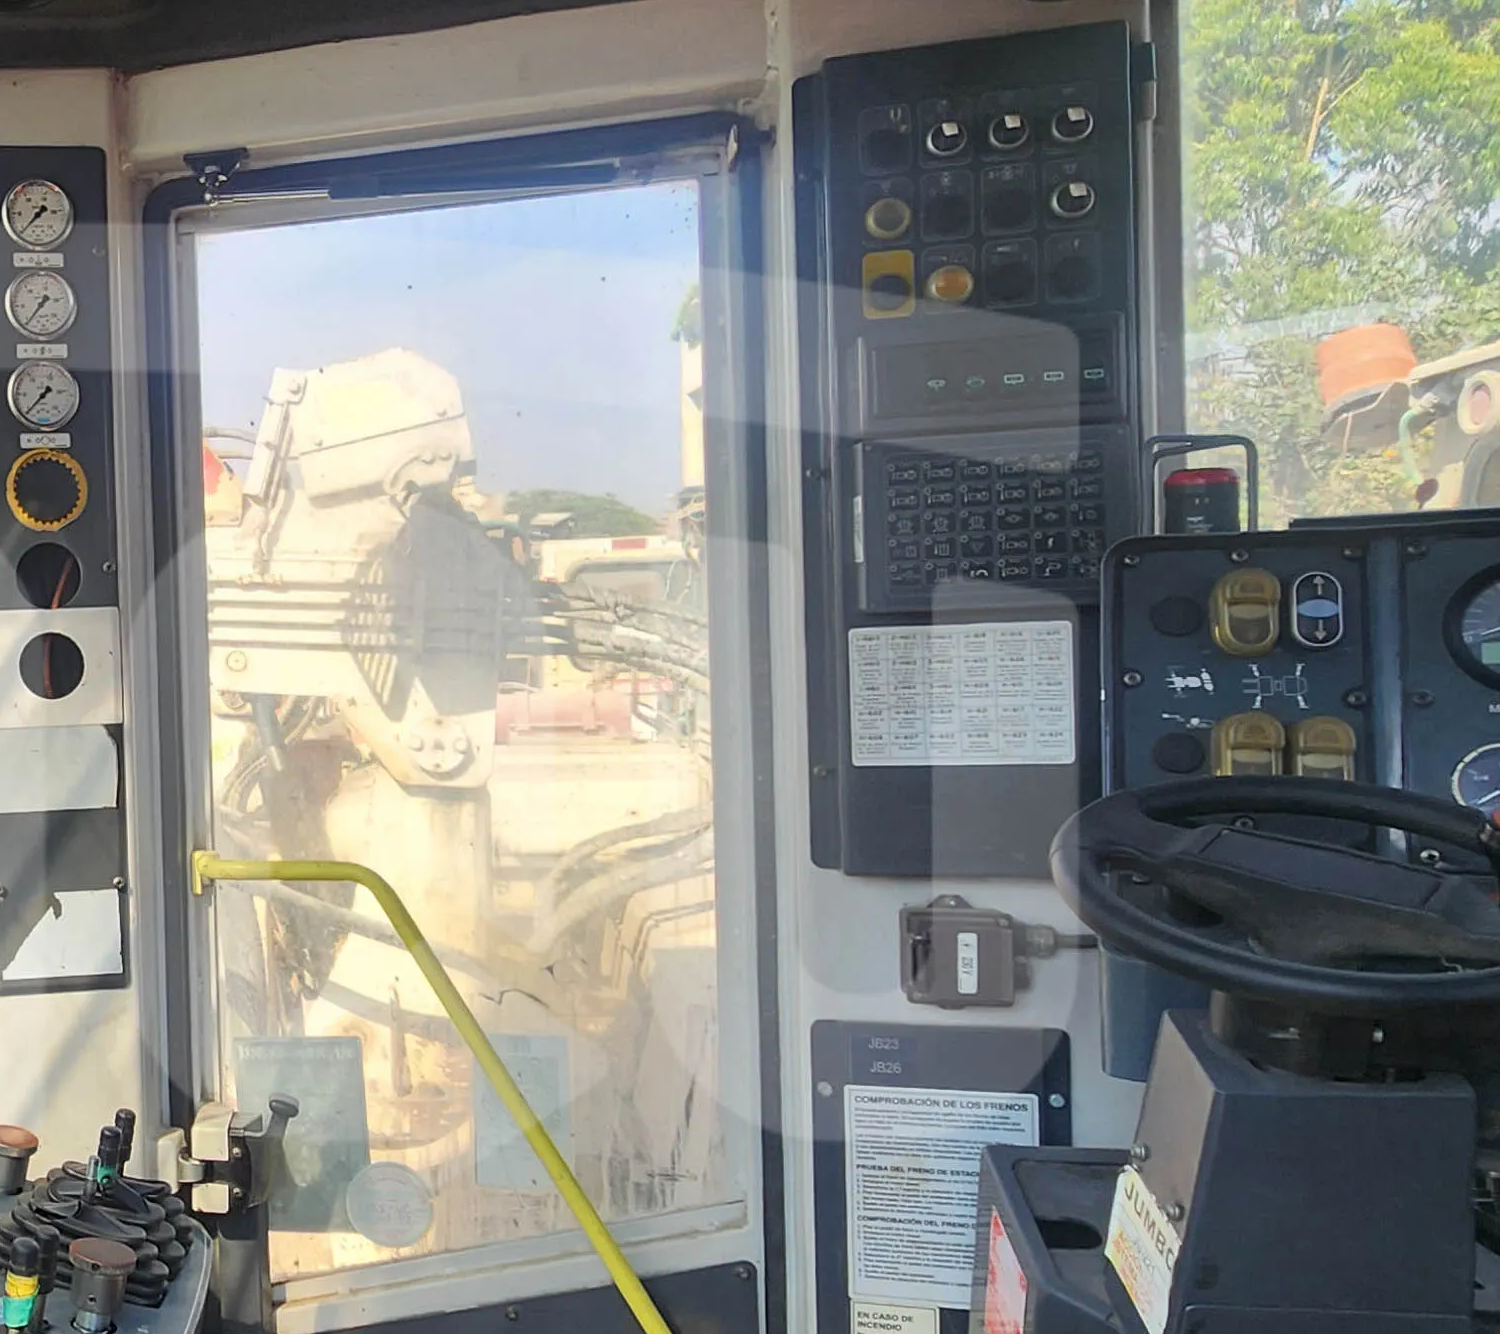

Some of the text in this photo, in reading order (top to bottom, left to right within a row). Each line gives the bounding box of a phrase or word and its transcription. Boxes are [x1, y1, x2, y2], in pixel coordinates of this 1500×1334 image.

[868, 1037, 899, 1050] JB23
[869, 1061, 902, 1075] JB26
[854, 1095, 1029, 1112] COMPROBACIÓN DE LOS FRENOS
[856, 1163, 888, 1172] PRUEBA
[890, 1165, 905, 1173] DEL
[907, 1166, 935, 1175] FRENO
[856, 1215, 922, 1226] COMPROBACIÓN
[923, 1220, 939, 1228] DEL
[941, 1221, 969, 1229] FRENO
[857, 1311, 914, 1323] EN CASO DE
[857, 1321, 902, 1331] INCENDIO
